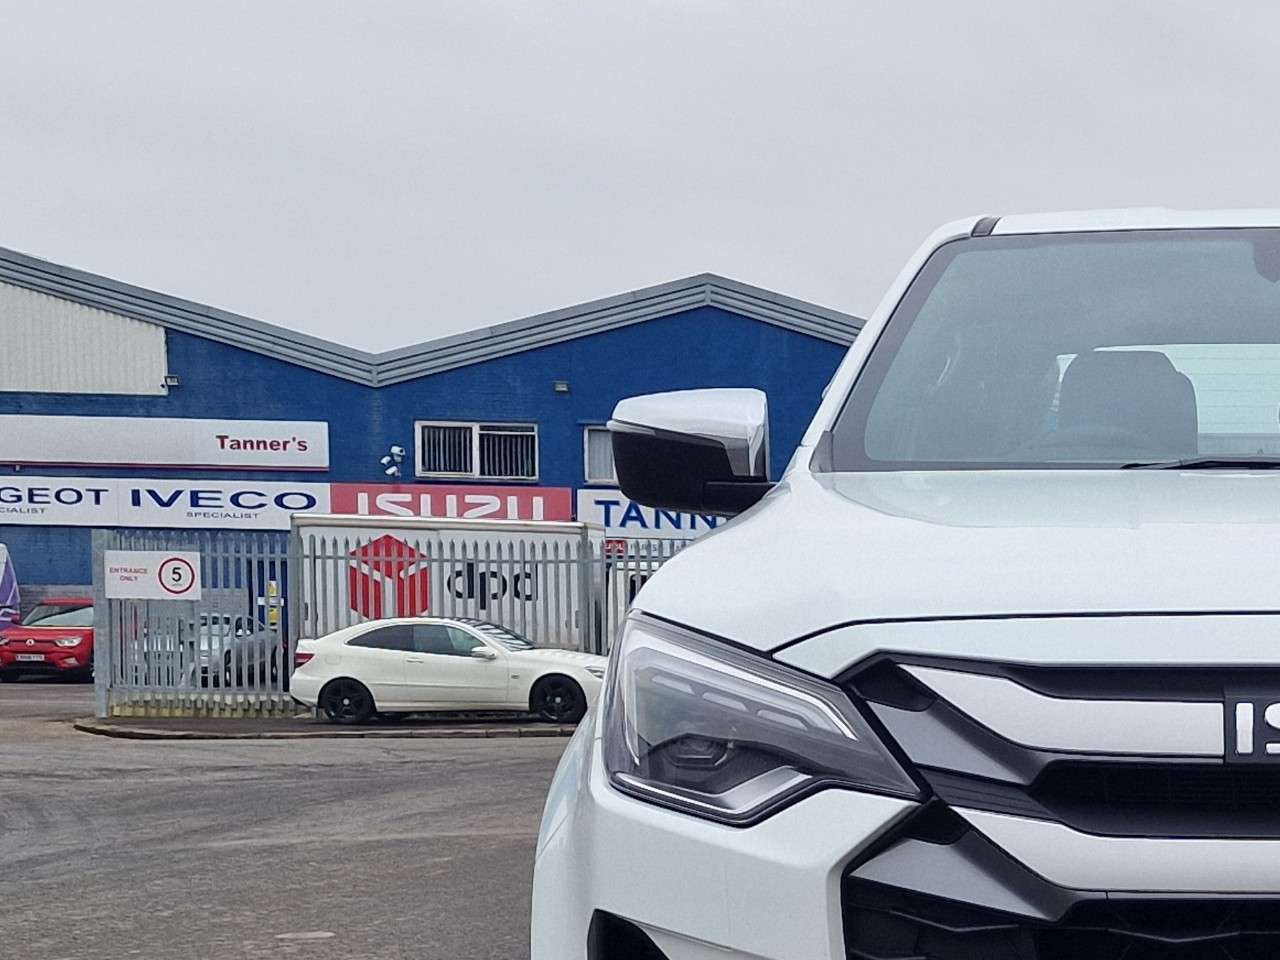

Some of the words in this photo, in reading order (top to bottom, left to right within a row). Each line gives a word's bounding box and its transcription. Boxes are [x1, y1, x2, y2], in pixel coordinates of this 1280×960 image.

[215, 434, 309, 452] Tanner's
[0, 486, 109, 506] GEOT
[130, 487, 317, 511] IVECO
[357, 491, 544, 520] ISUZU
[186, 510, 261, 520] SPECIALIST
[171, 567, 182, 582] 5
[447, 561, 539, 610] dpd
